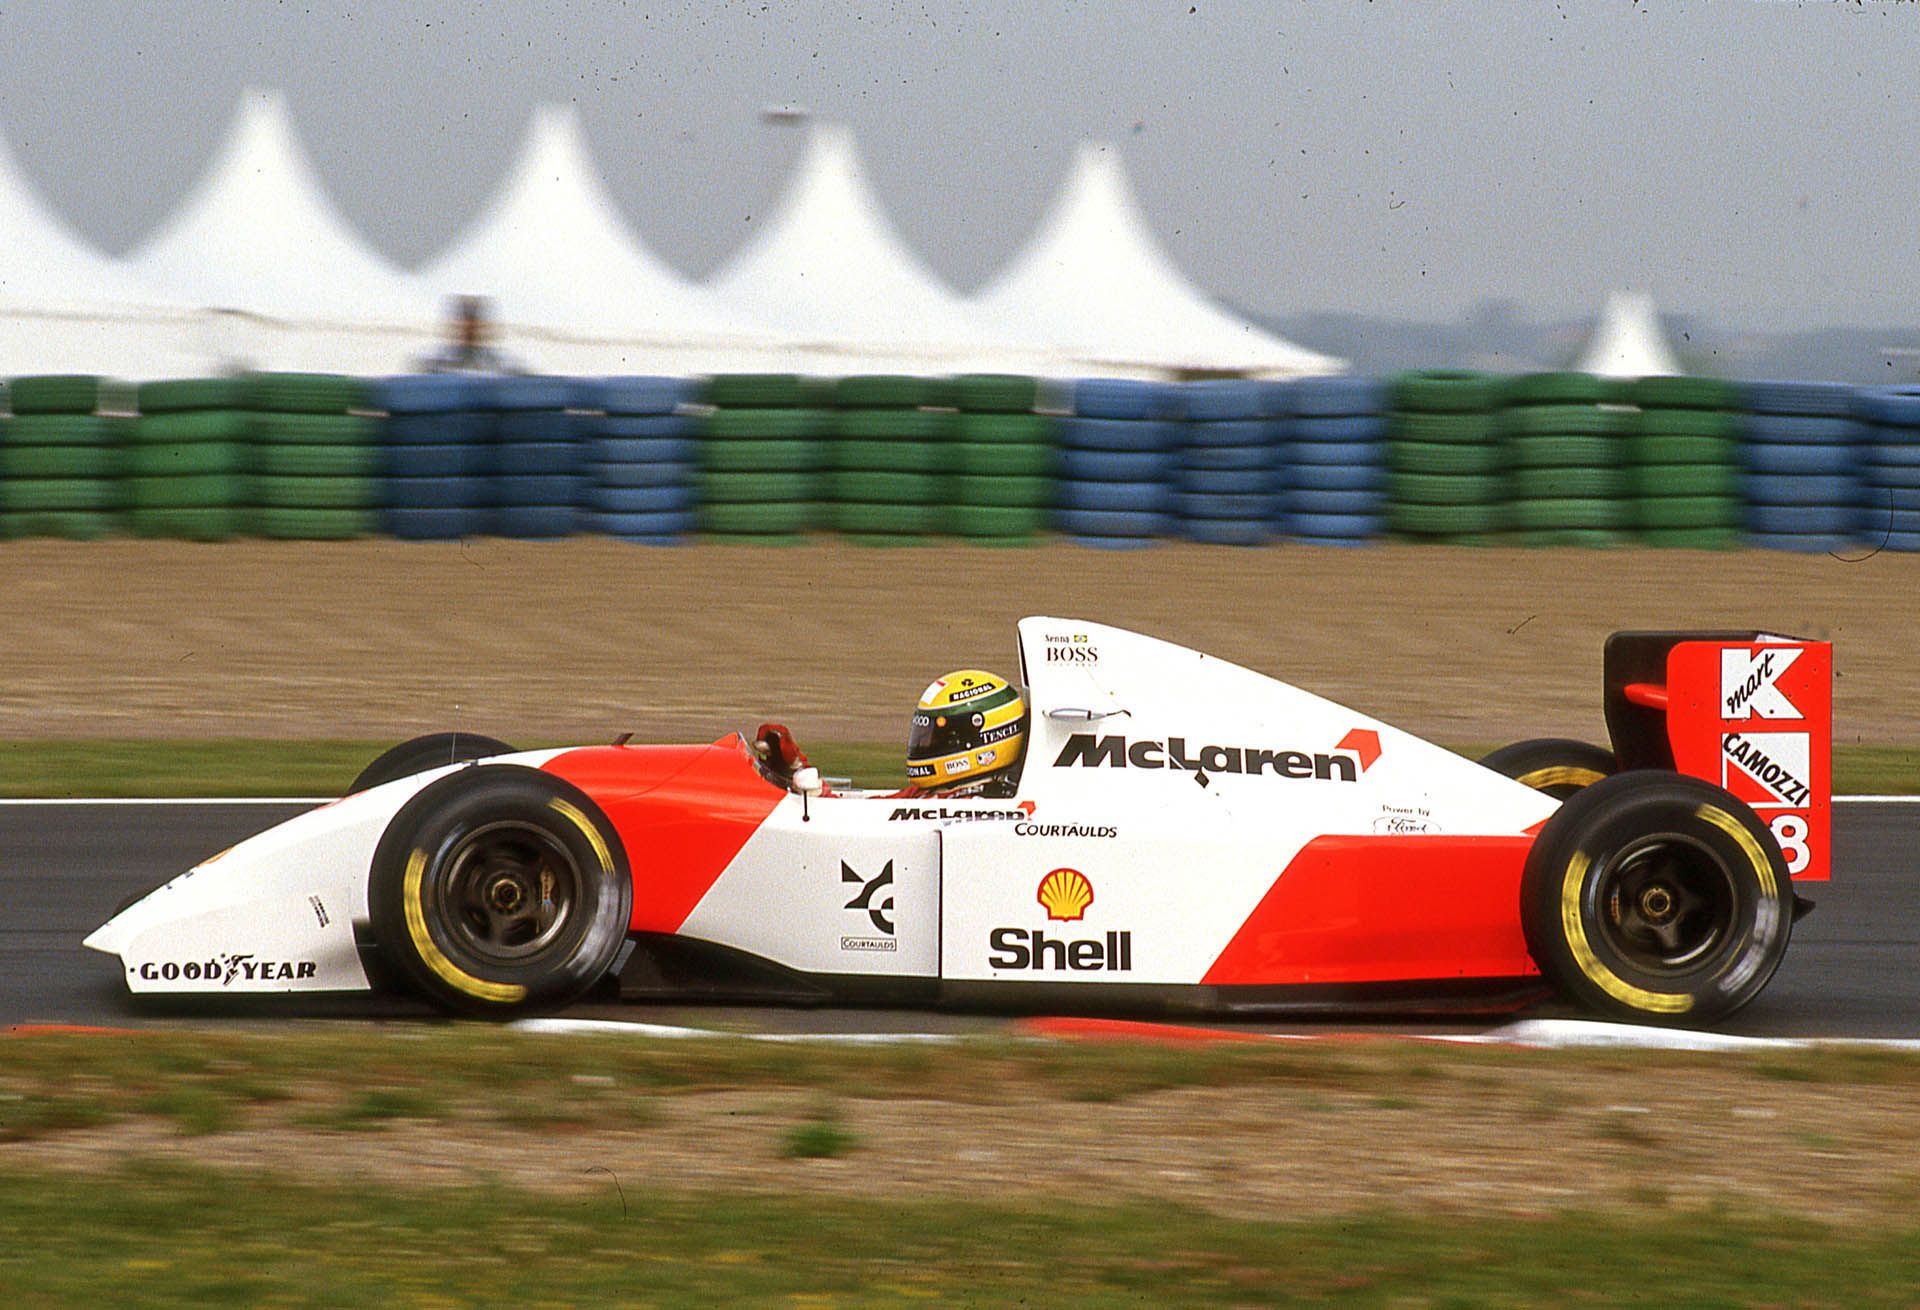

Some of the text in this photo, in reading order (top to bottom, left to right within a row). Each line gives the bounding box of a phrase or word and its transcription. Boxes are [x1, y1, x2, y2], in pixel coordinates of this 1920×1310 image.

[1045, 634, 1070, 643] Senna
[1047, 647, 1098, 661] BOSS
[1726, 652, 1775, 714] mart
[952, 683, 993, 700] NACIONAL
[946, 759, 969, 770] BOSS
[1052, 733, 1359, 785] McLaren
[1722, 733, 1810, 807] CAMOZZI
[888, 807, 1026, 822] McLaren
[1014, 822, 1118, 838] COURTAULDS
[1770, 815, 1811, 874] 8
[843, 938, 895, 949] COURTAULDS
[989, 928, 1132, 971] Shell
